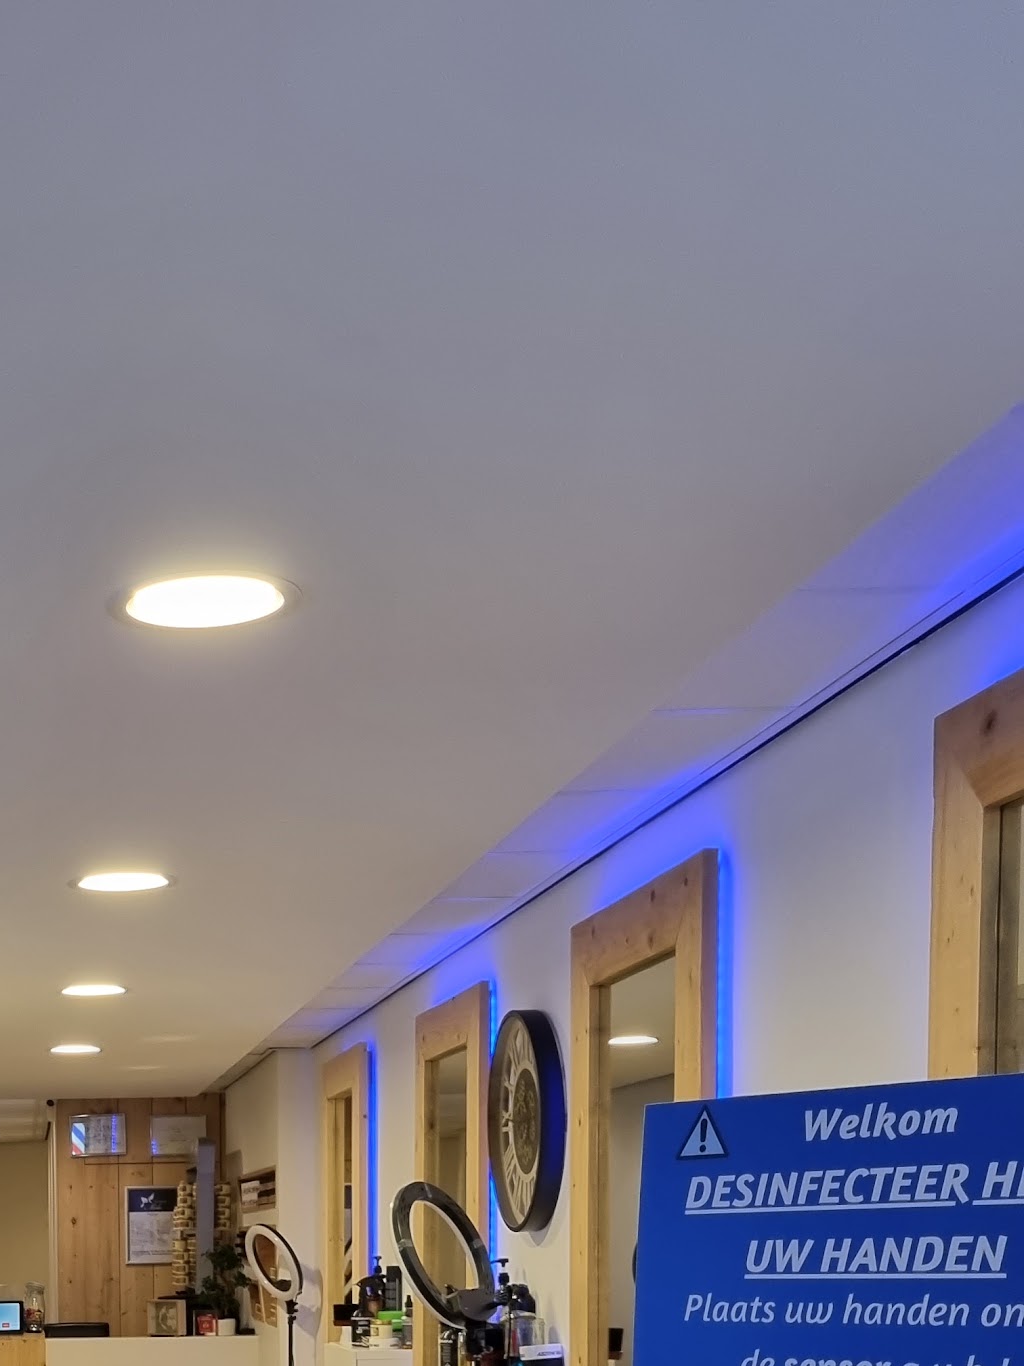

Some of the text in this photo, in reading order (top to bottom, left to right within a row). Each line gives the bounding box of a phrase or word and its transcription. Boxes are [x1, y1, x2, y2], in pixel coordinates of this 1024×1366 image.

[804, 1102, 959, 1142] Welkom
[685, 1163, 970, 1209] DESINFECTEER
[745, 1234, 1008, 1273] UW HANDEN
[683, 1293, 776, 1324] Plaats
[784, 1301, 834, 1325] uw
[842, 1293, 970, 1327] handen
